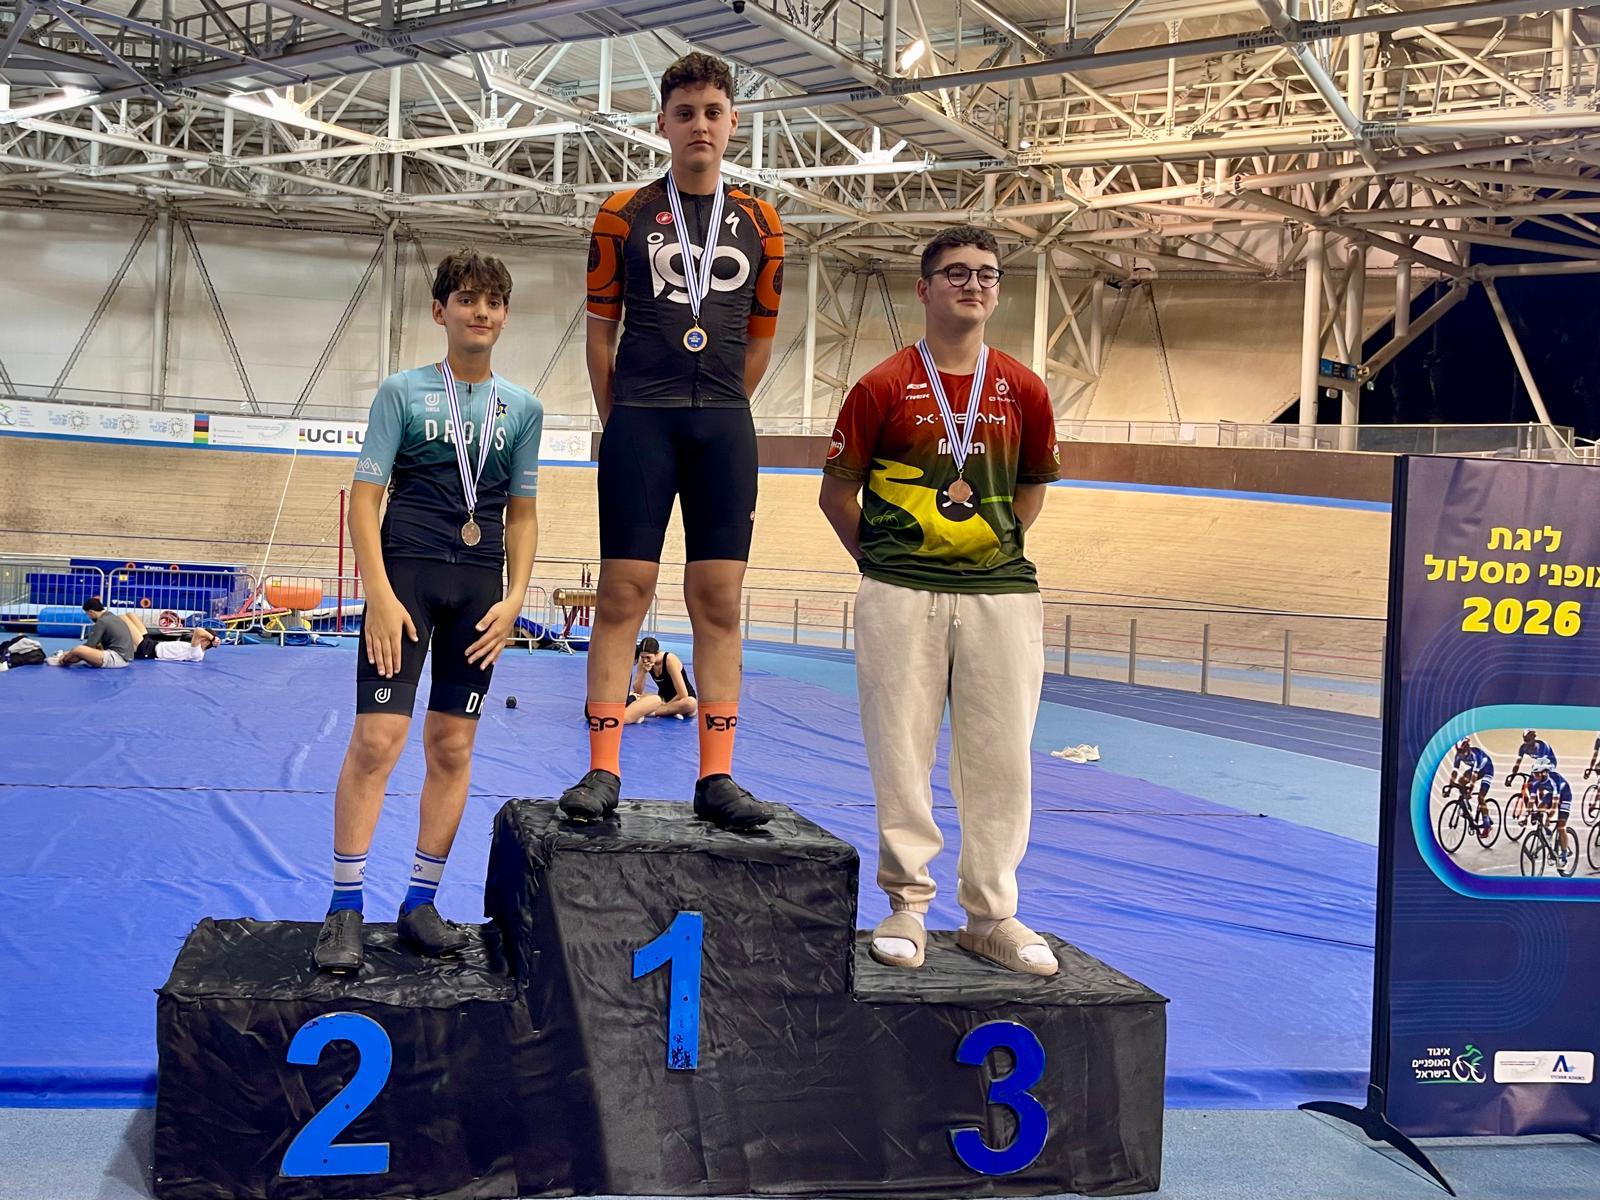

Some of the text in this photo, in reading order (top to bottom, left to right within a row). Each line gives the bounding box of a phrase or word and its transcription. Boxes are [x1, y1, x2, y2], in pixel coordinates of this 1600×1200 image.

[307, 428, 342, 444] UCI
[425, 419, 507, 451] DROS
[1487, 525, 1563, 553] ליגת
[1424, 553, 1531, 584] מסלול
[1461, 596, 1581, 637] 2026
[632, 910, 704, 1071] 1
[1412, 1058, 1451, 1068] האופניים
[1426, 1047, 1451, 1056] איגוד
[1415, 1069, 1451, 1079] בישראל
[279, 1013, 392, 1177] 2
[949, 1020, 1048, 1176] 3
